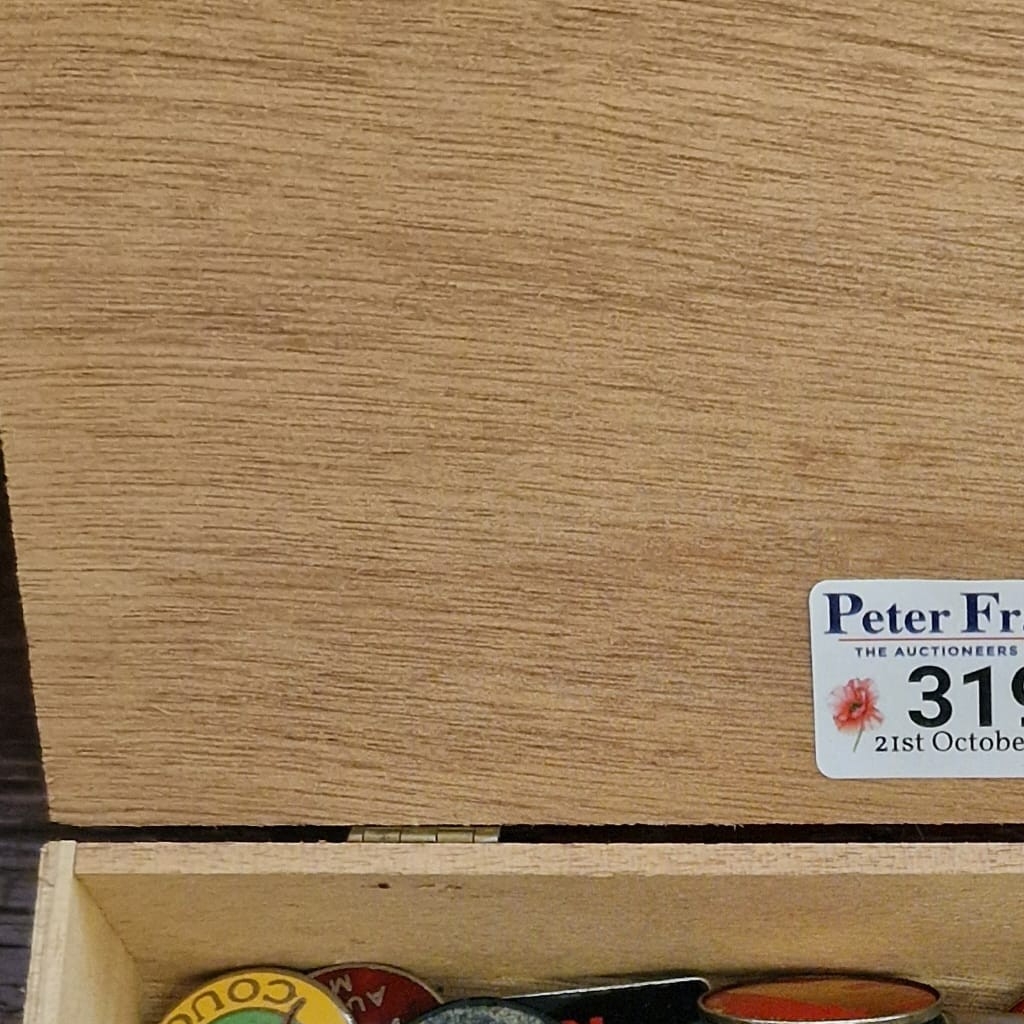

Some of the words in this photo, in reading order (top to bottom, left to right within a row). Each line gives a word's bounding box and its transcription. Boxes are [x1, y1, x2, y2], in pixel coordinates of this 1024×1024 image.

[823, 592, 951, 635] Peter
[855, 646, 887, 658] THE
[894, 645, 1019, 657] AUCTIONEERS
[874, 732, 926, 753] 21st
